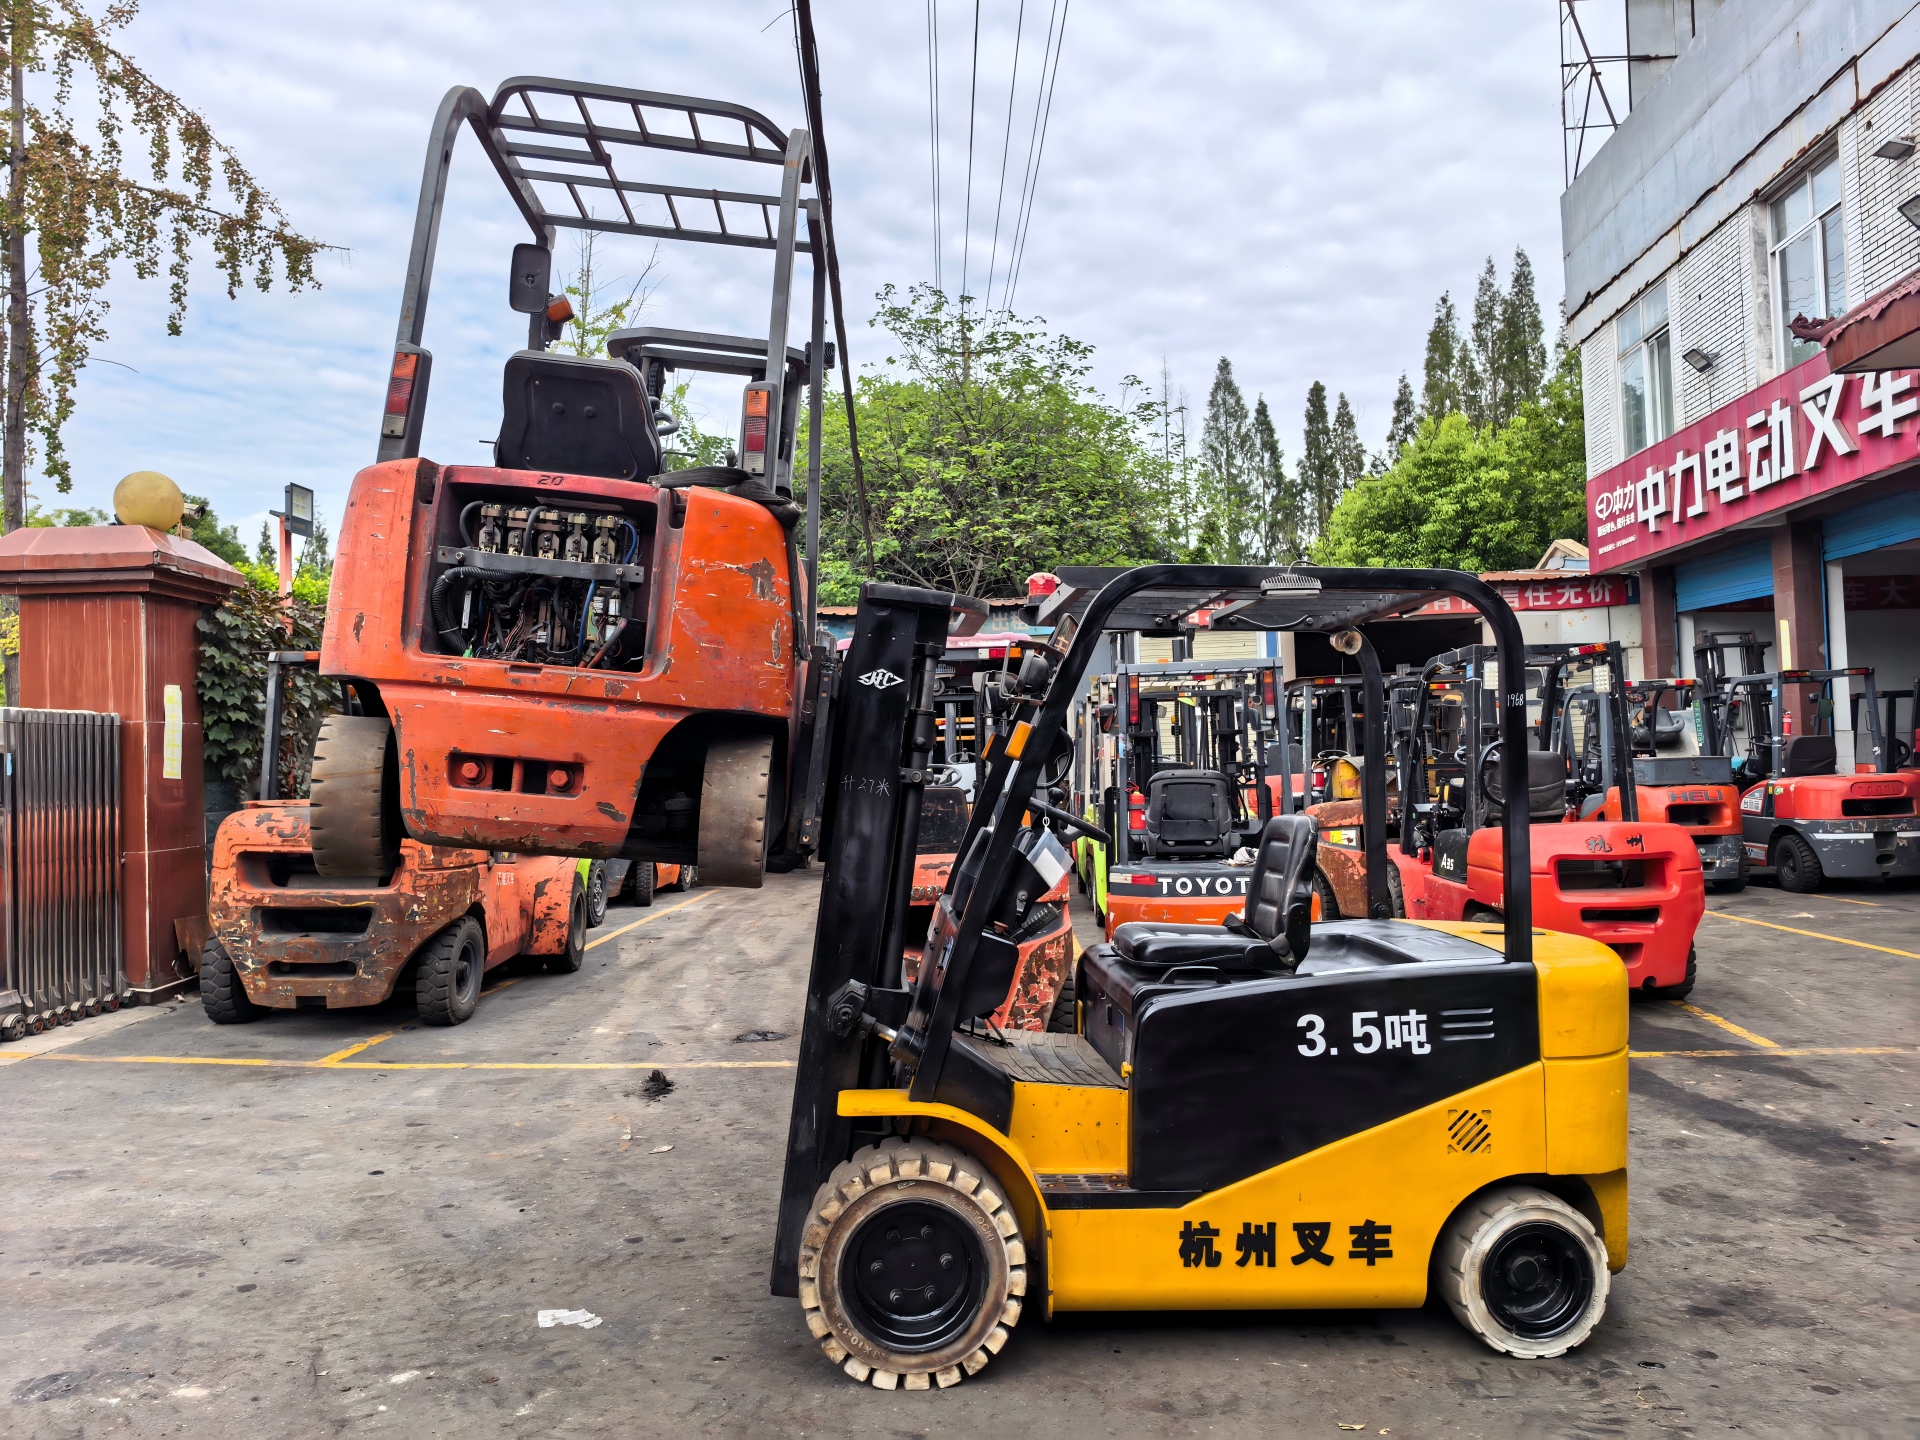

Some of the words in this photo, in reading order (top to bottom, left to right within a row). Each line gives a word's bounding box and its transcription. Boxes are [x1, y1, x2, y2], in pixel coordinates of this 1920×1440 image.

[1636, 371, 1917, 533] 中力电动叉车
[537, 473, 565, 486] 20
[1612, 480, 1635, 516] 中力
[1507, 692, 1524, 707] 1968
[1667, 790, 1723, 802] HELI
[1296, 1009, 1431, 1057] 3.5吨
[1178, 1218, 1394, 1269] 杭州叉车
